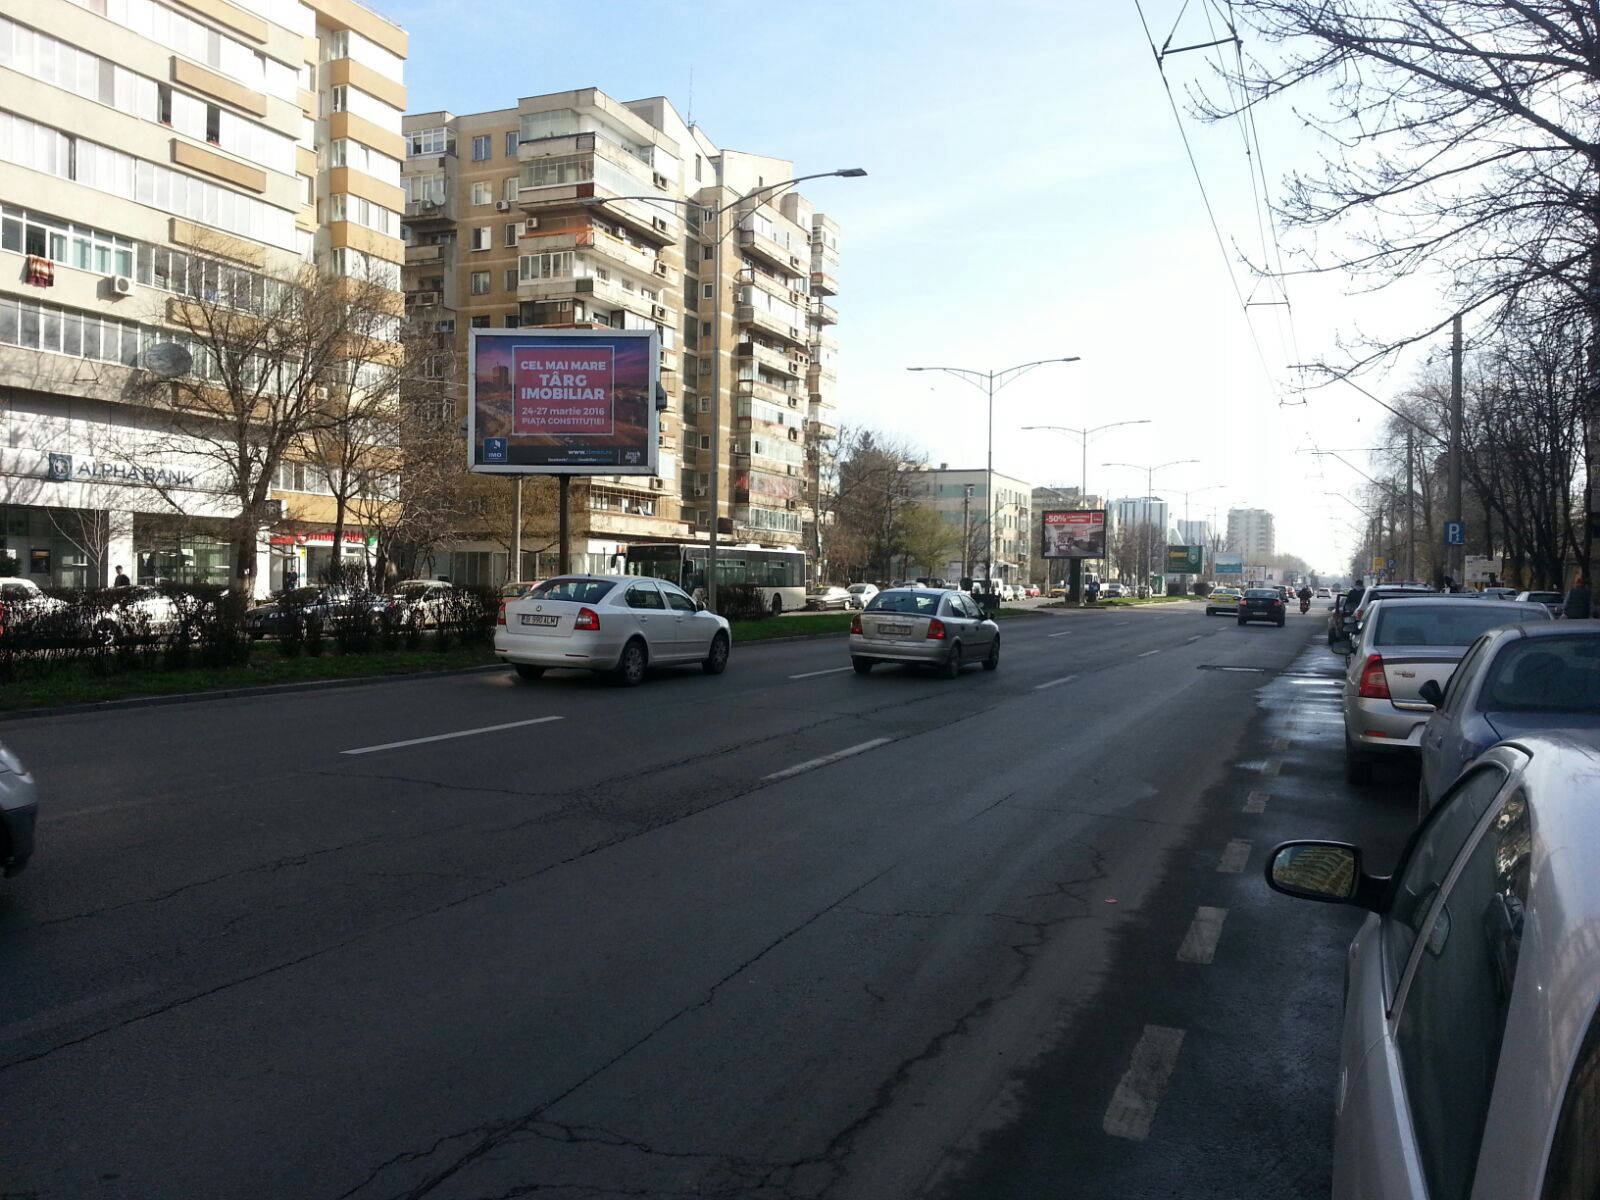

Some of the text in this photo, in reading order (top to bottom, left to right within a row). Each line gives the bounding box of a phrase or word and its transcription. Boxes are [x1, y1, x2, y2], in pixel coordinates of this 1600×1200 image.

[521, 360, 606, 372] CEL MAI MARE
[539, 370, 587, 386] TÂRG
[521, 387, 605, 400] IMOBILIAR
[522, 407, 605, 415] 24-27 martie 2016
[77, 461, 195, 486] ALPHA BANK
[1046, 515, 1067, 523] -50%
[1448, 523, 1460, 542] P
